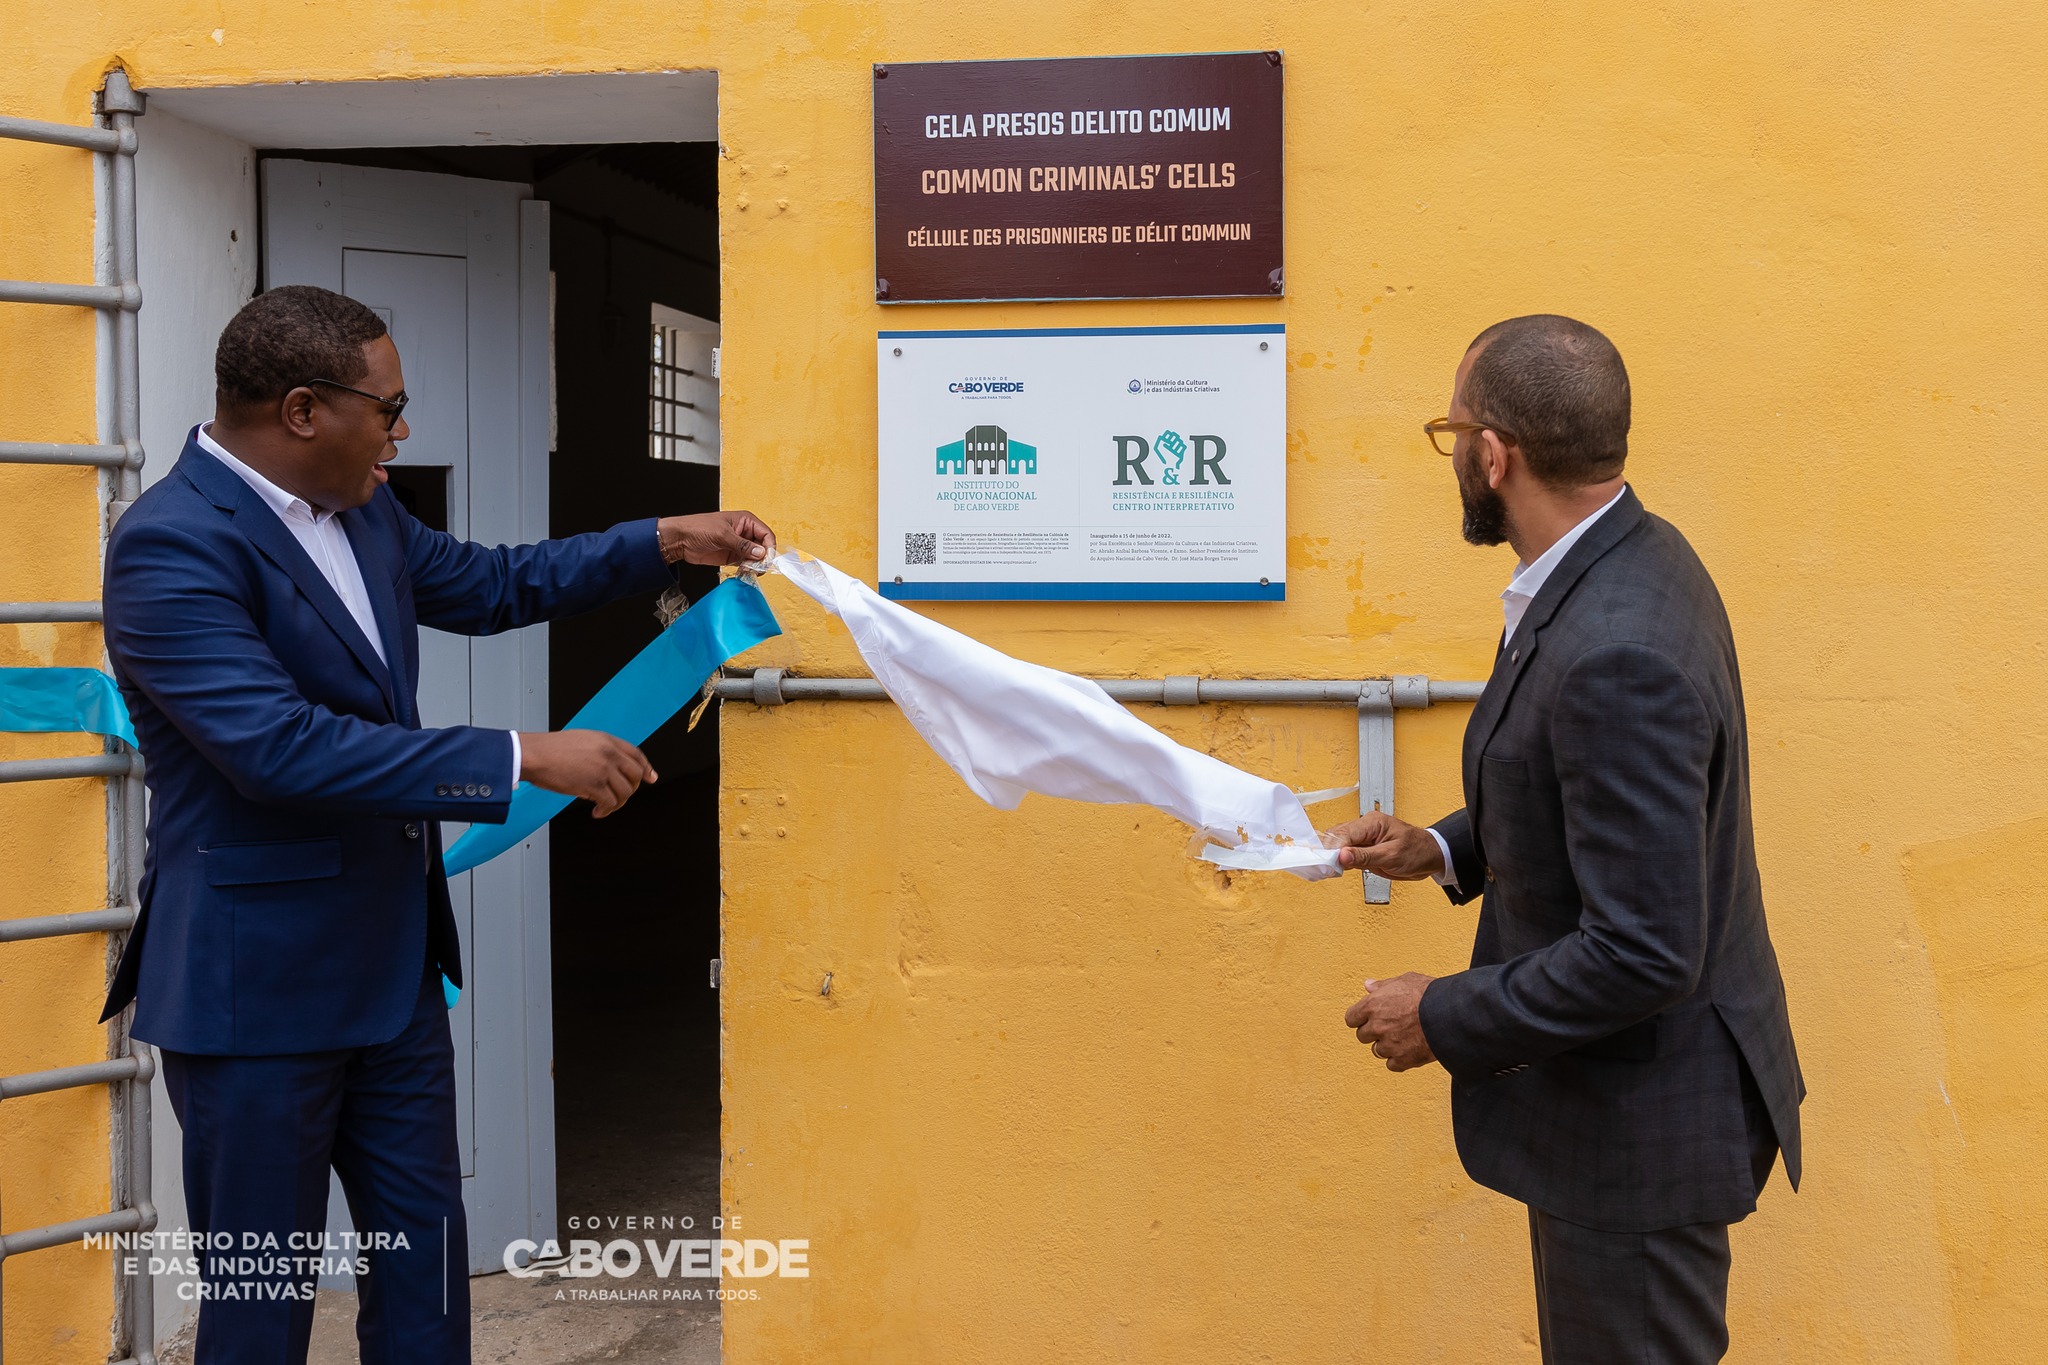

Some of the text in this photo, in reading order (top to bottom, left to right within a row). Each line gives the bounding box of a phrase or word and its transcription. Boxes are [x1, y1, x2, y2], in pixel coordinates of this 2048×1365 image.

[926, 107, 1230, 138] CELA PRESOS DELITO COMUM
[921, 168, 1022, 195] COMMON
[1166, 162, 1236, 189] CELLS
[907, 222, 1251, 248] CÉLLULE DES PRISONNIERS DE DÉLIT COMMUN
[949, 382, 1024, 392] CABO VERDE
[1146, 379, 1176, 387] Ministério
[954, 481, 1004, 489] INSTITUTO
[936, 492, 1038, 502] ARQUIVO NACIONAL
[1112, 490, 1234, 500] RESISTÊNCIA E RESILIÊNCIA
[954, 502, 1020, 512] DE CABO VERDE
[1112, 502, 1235, 511] CENTRO INTERPRETATIVO
